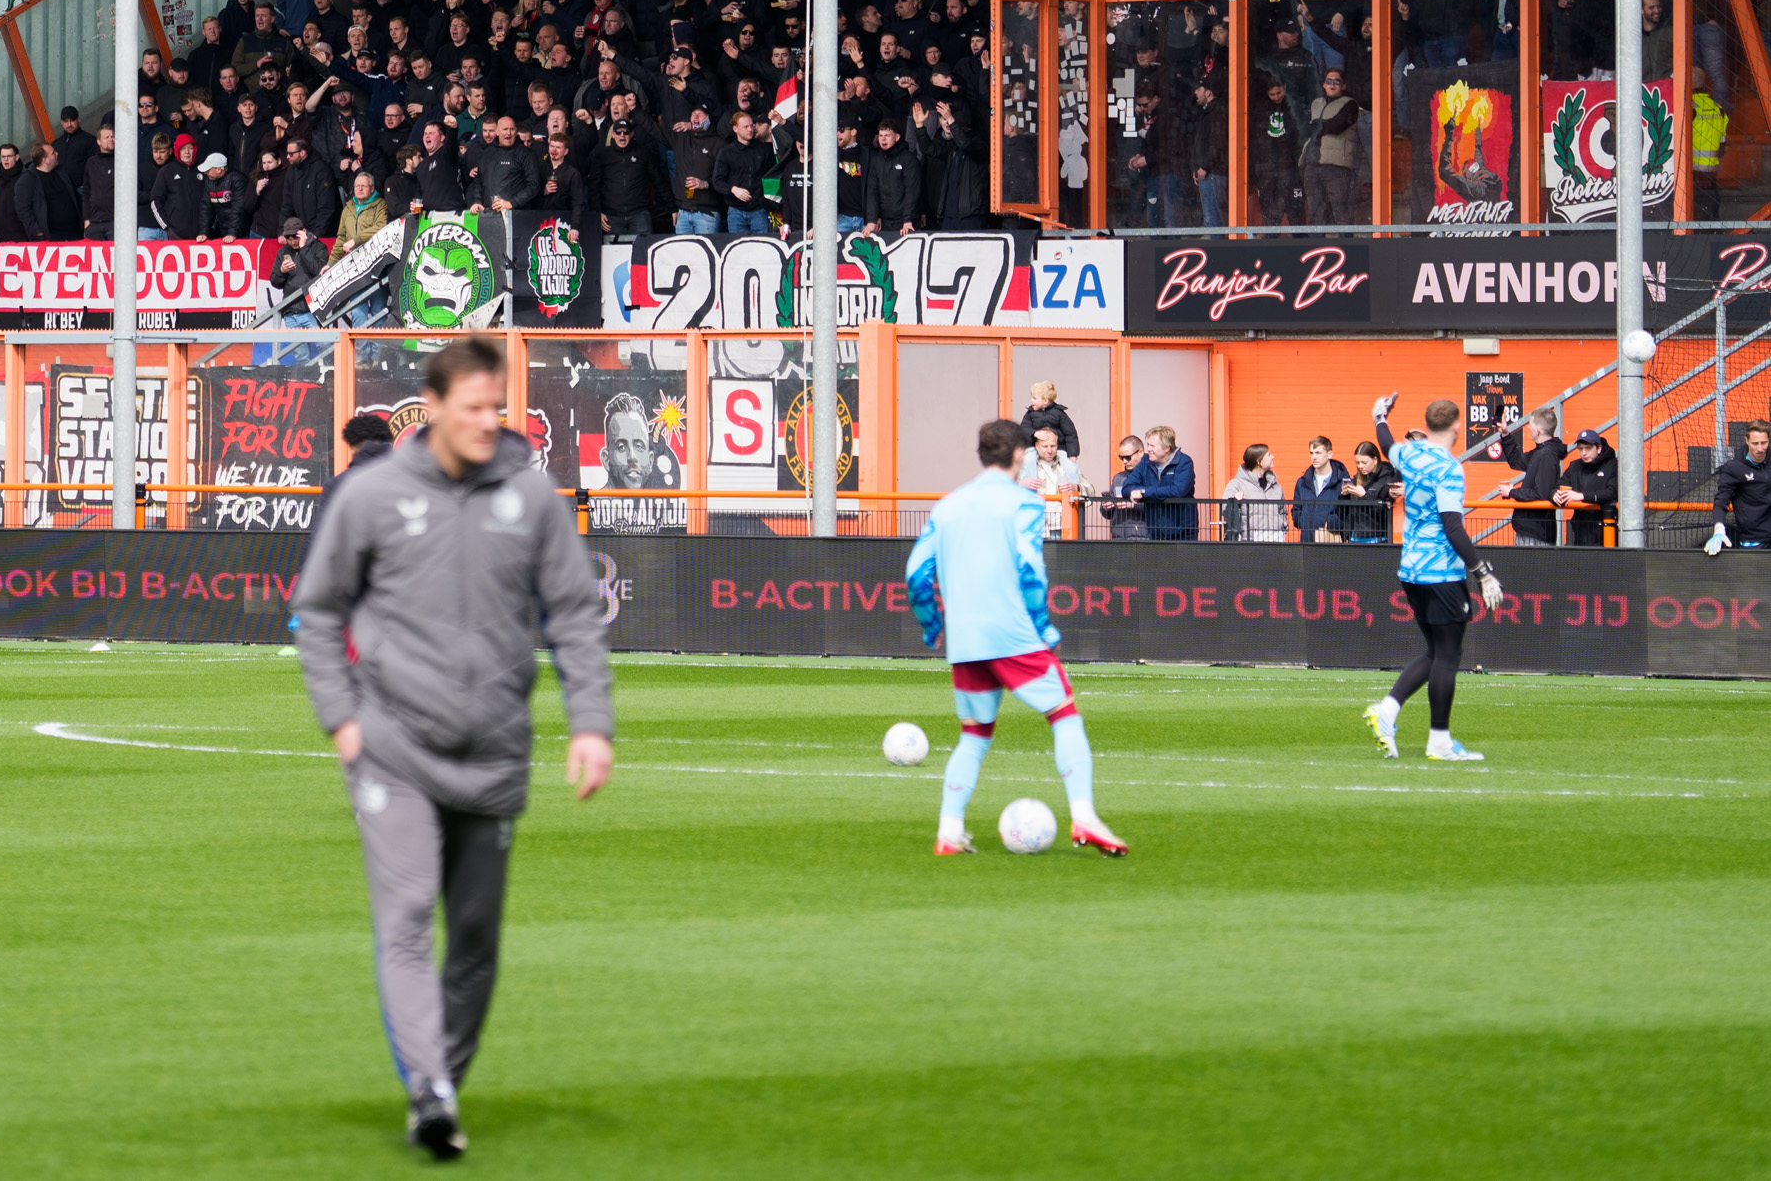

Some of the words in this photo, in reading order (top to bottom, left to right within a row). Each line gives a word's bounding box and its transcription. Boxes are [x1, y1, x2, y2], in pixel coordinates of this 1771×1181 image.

[1554, 171, 1675, 205] Rotteram
[407, 223, 491, 270] ROTTERDAM
[540, 275, 571, 296] ZIJDE
[1031, 263, 1106, 309] ZA
[1293, 246, 1368, 310] Bar
[138, 310, 178, 329] ROBEY
[232, 310, 256, 329] ROB
[648, 235, 786, 375] 20
[880, 233, 1015, 327] 17
[223, 378, 322, 425] FIGHT
[787, 389, 813, 430] ALLE
[1470, 405, 1489, 422] BB
[1472, 395, 1487, 405] VAK
[1502, 395, 1518, 405] VAK
[220, 421, 279, 461] FOR
[282, 426, 316, 460] US
[723, 389, 764, 456] S
[278, 465, 312, 488] DIE
[214, 494, 270, 531] FOR
[270, 497, 315, 532] YOU
[72, 569, 127, 600] BIJ
[141, 571, 301, 602] B-ACTIV
[711, 579, 909, 613] B-ACTIVE
[1155, 586, 1219, 619] DE
[1234, 587, 1374, 628] CLUB,
[1565, 593, 1628, 628] JIJ
[1646, 596, 1763, 631] OOK
